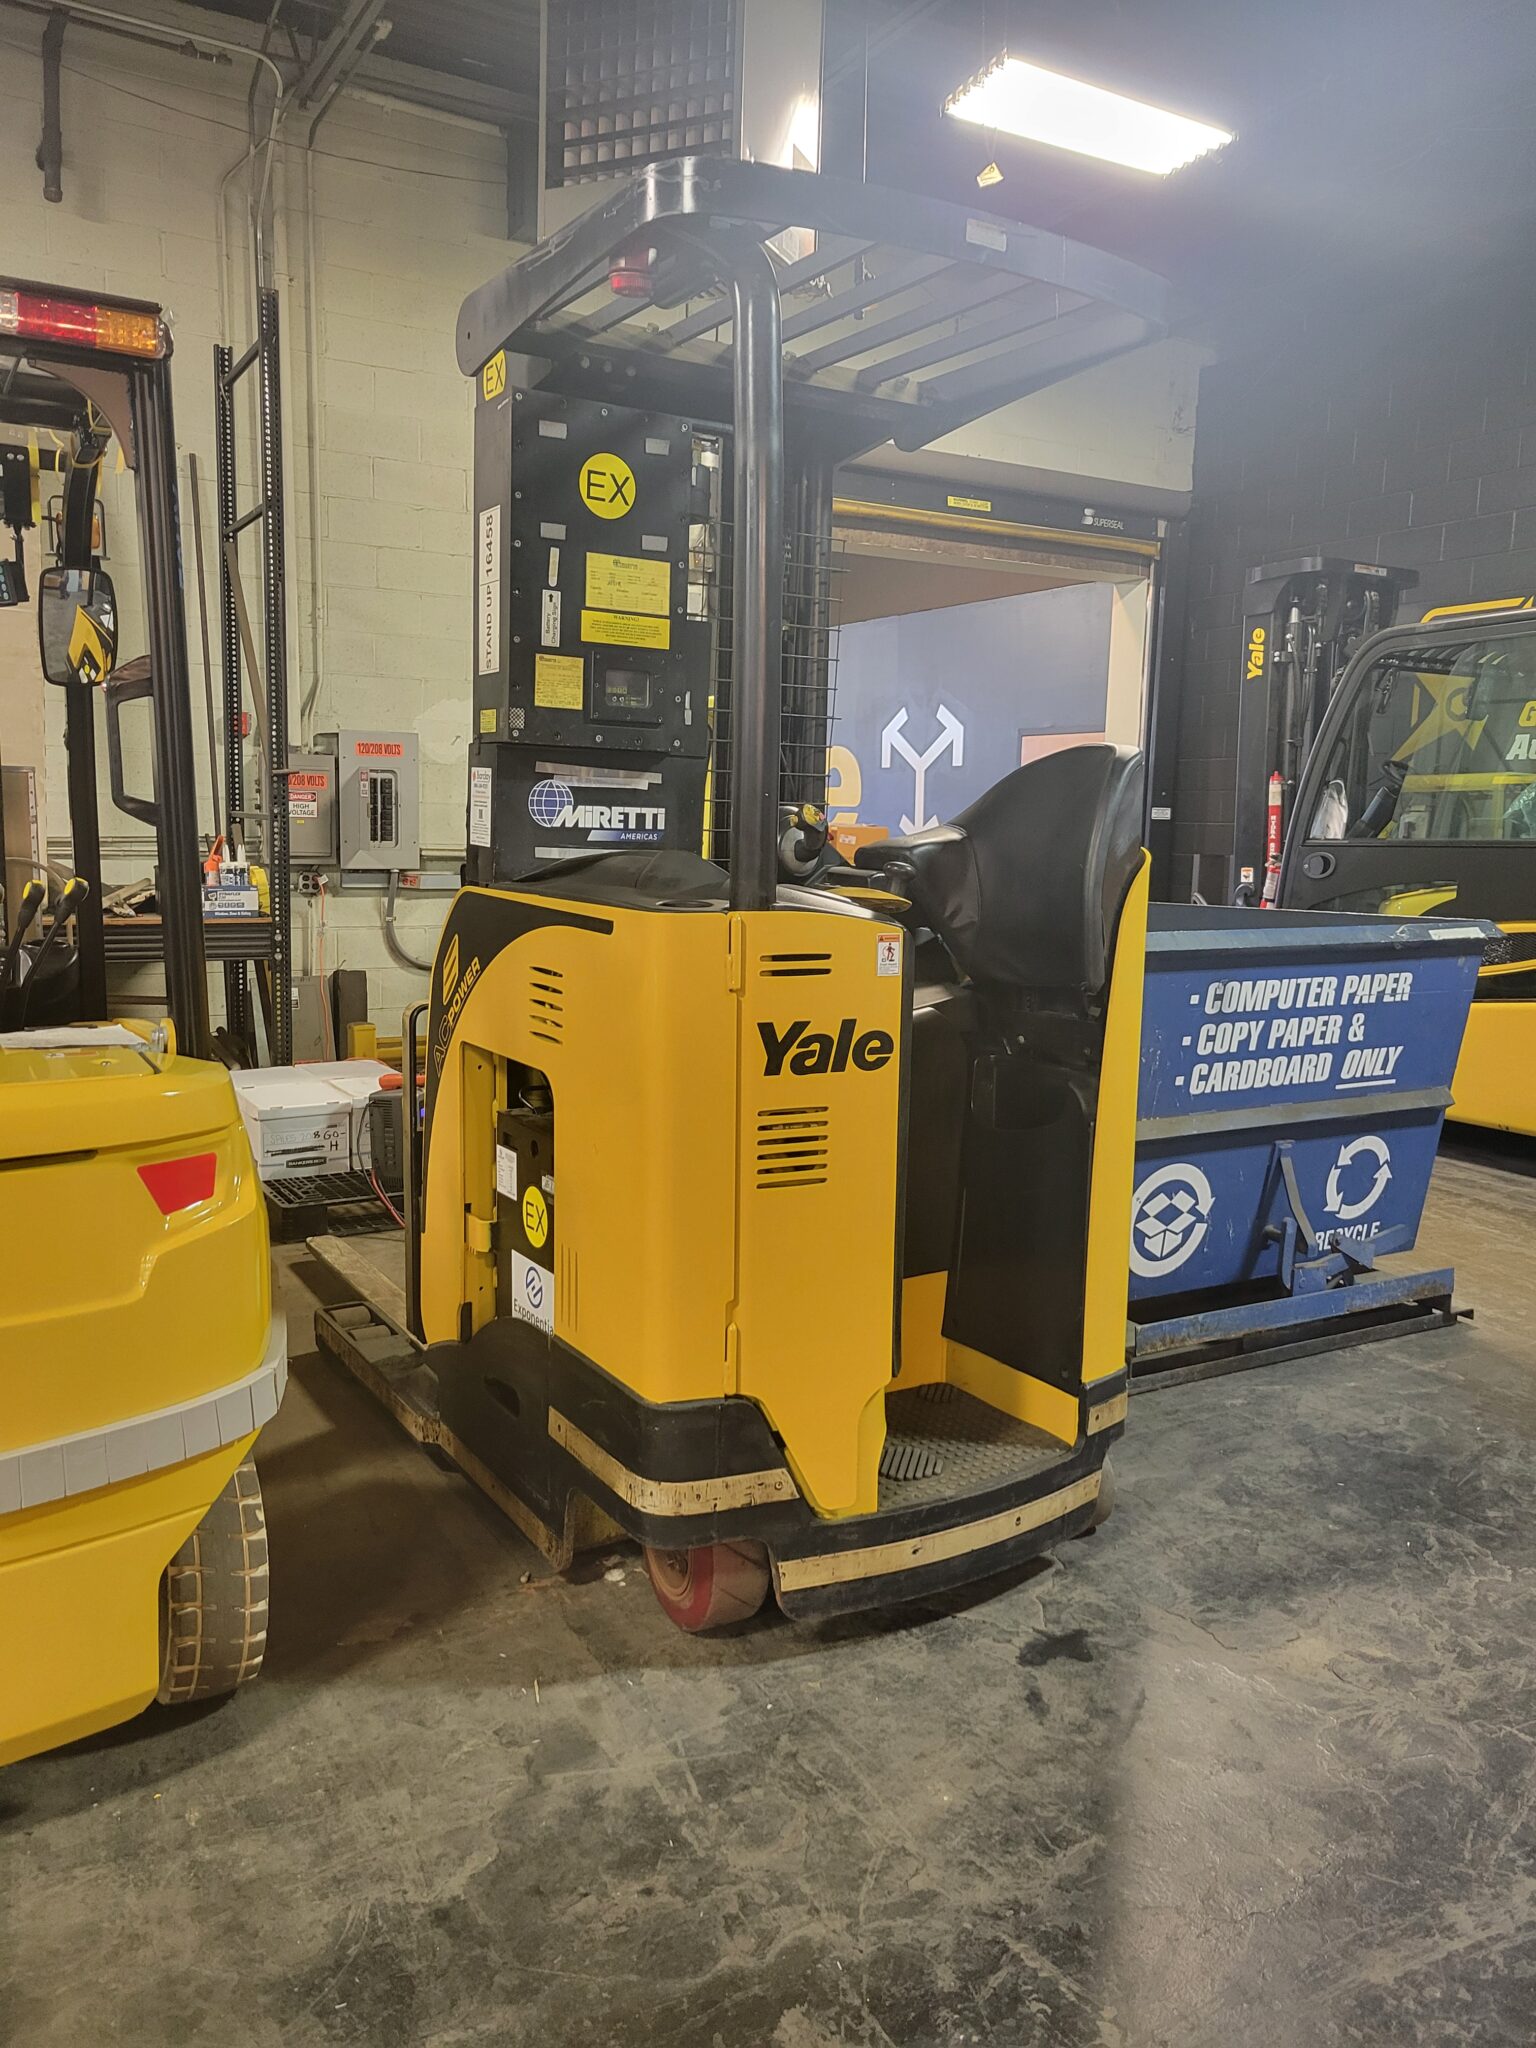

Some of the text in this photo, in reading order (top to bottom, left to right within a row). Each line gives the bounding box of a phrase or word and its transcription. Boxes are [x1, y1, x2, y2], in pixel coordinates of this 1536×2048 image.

[485, 358, 504, 394] EX
[586, 469, 630, 507] EX
[1093, 517, 1124, 530] SUPERSEAL
[485, 514, 493, 669] STAND UP 16458
[1247, 627, 1265, 680] Yale
[357, 743, 401, 755] 120/208 VOLTS
[307, 775, 325, 787] VOLTS
[1205, 972, 1413, 1015] COMPUTER PAPER
[434, 956, 481, 1077] AC POWER
[1197, 1013, 1365, 1056] COPY PAPER &
[757, 1018, 894, 1077] Yale
[1189, 1046, 1404, 1095] CARDBOARD ONLY
[525, 1201, 545, 1237] EX
